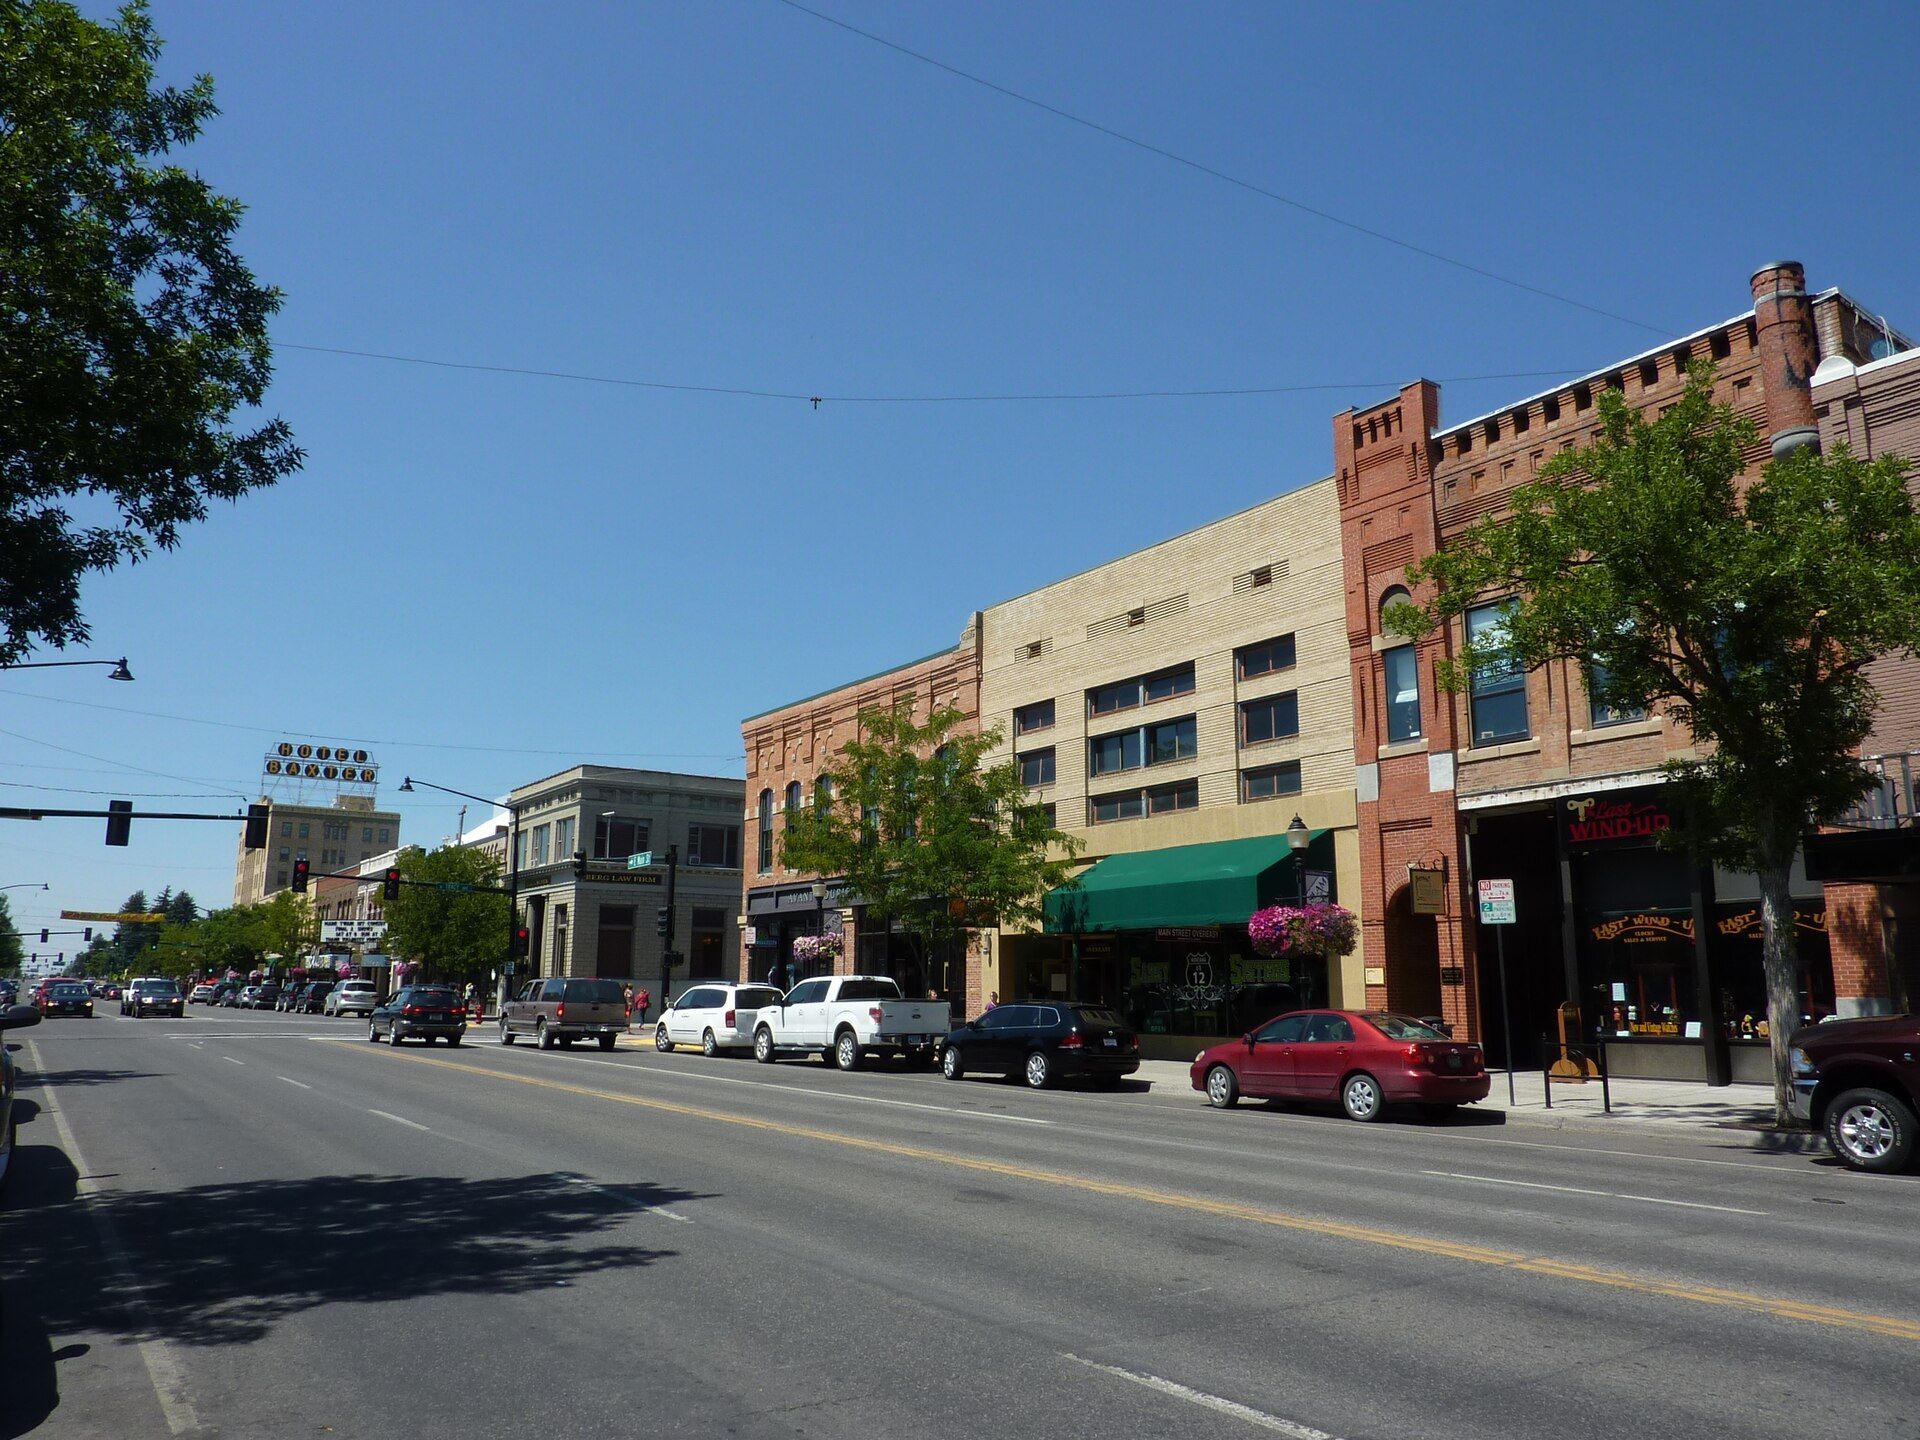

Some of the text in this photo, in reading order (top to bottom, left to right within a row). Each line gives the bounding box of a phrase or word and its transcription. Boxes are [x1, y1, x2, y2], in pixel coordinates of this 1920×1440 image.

[280, 743, 364, 763] HOTEL
[268, 760, 373, 782] BAXTER
[1568, 814, 1671, 841] WIND-UP
[586, 873, 656, 883] BERG LAW FIRM
[1480, 881, 1491, 890] NO
[1592, 916, 1629, 940] LAST
[1717, 909, 1756, 934] LAST
[1158, 928, 1171, 936] MAIN
[1172, 928, 1191, 937] STREET
[1192, 971, 1205, 984] 12
